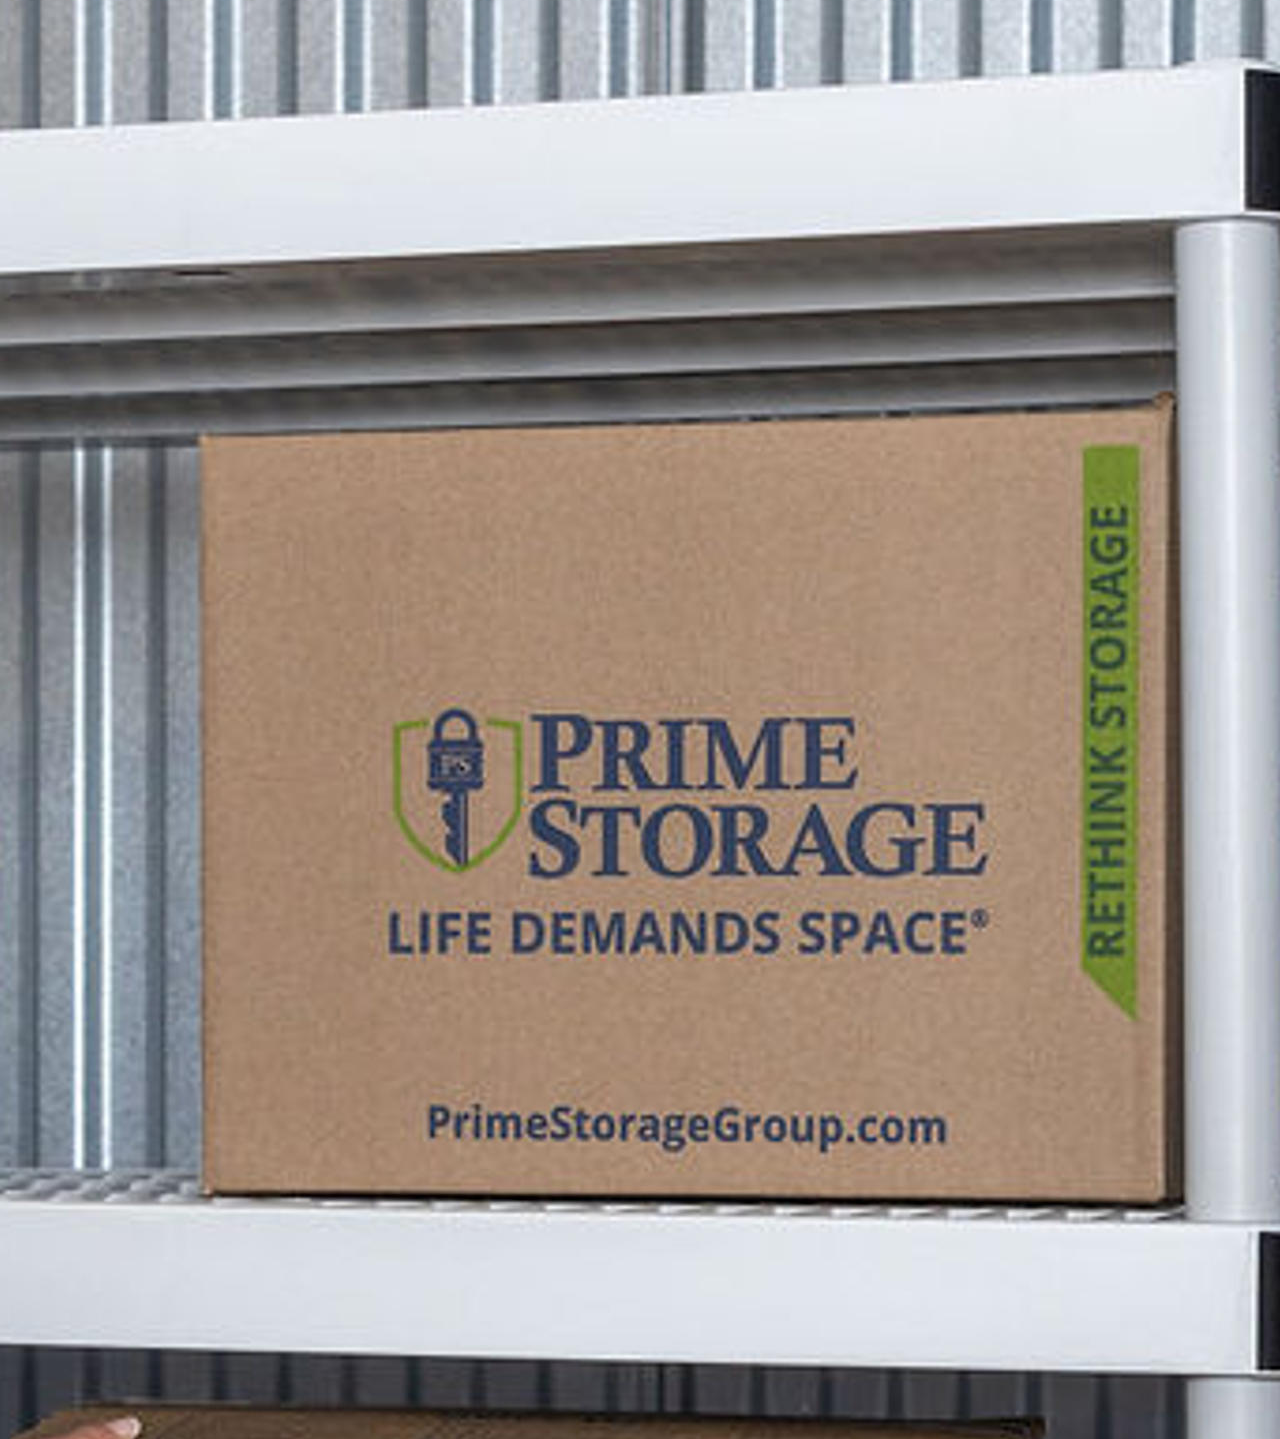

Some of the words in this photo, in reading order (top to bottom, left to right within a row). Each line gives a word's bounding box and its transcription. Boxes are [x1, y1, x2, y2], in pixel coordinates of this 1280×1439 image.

[1088, 506, 1129, 729] STORAGE
[530, 714, 858, 793] PRIME
[529, 798, 988, 879] STORAGE
[1086, 745, 1127, 958] RETHINK
[389, 912, 491, 955] LIFE
[512, 911, 780, 955] DEMANDS
[428, 1104, 947, 1153] PrimeStorageGroup.com
